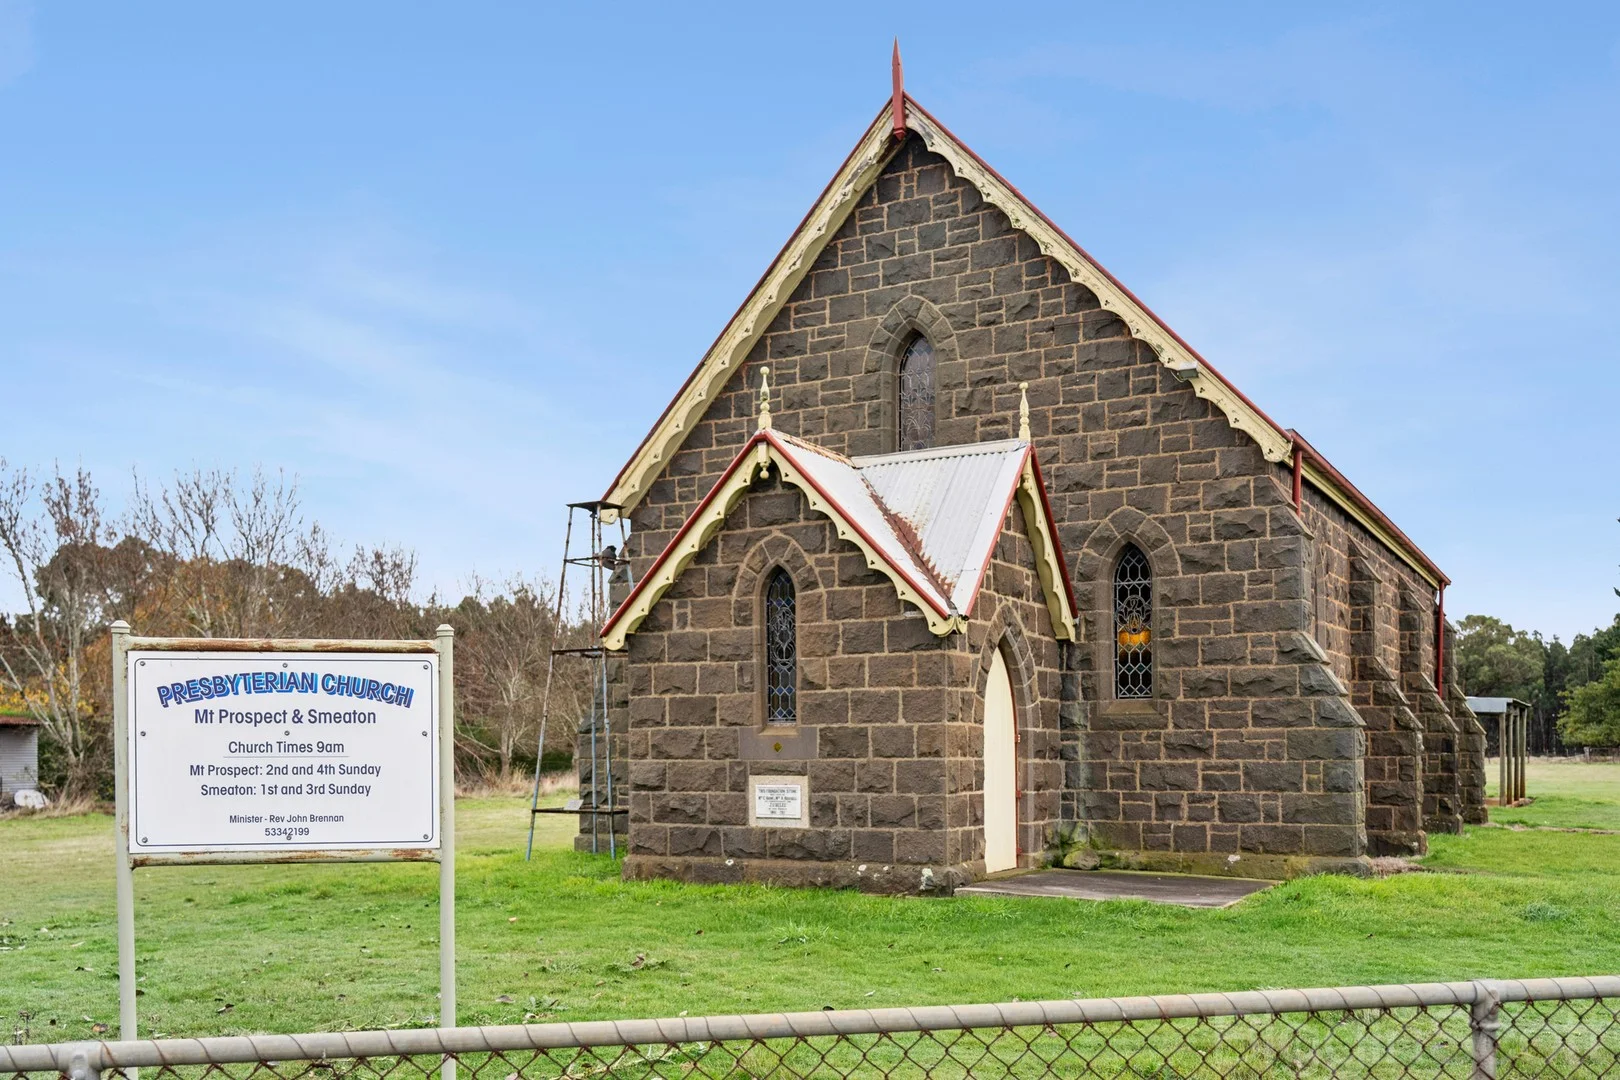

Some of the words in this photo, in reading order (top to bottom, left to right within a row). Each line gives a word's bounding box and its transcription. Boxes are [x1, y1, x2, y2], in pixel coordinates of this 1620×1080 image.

[157, 672, 318, 708] PRESBYTERIAN
[321, 673, 414, 708] CHURCH
[194, 709, 214, 724] Mt
[219, 708, 287, 727] Prospect
[291, 709, 304, 724] &
[307, 708, 377, 724] Smeaton
[228, 741, 273, 754] Church
[276, 741, 313, 754] Times
[316, 741, 345, 754] 9am
[189, 765, 205, 776] Mt
[207, 764, 263, 778] Prospect:
[265, 764, 289, 776] 2nd
[291, 764, 314, 776] and
[316, 764, 336, 776] 4th
[338, 764, 382, 778] Sunday
[200, 784, 257, 796] Smeaton:
[260, 784, 278, 796] 1st
[281, 784, 303, 796] and
[306, 783, 326, 795] 3rd
[328, 783, 372, 797] Sunday
[229, 814, 263, 823] Minister
[269, 814, 285, 823] Rev
[286, 814, 308, 823] John
[309, 814, 345, 823] Brennan
[264, 827, 310, 837] 53342199
